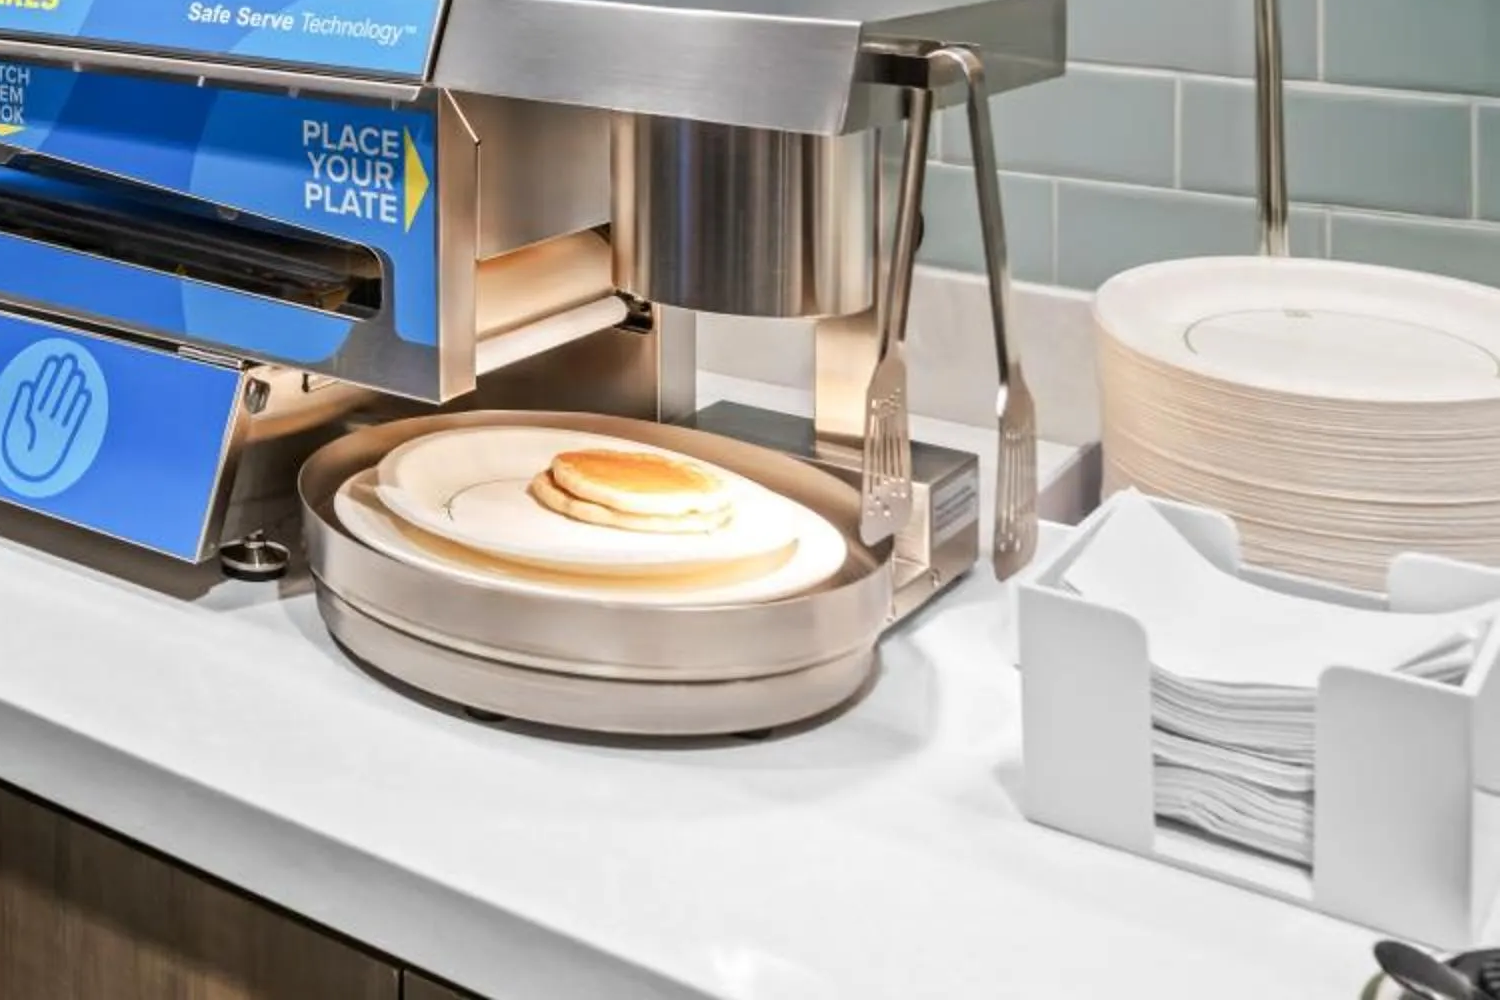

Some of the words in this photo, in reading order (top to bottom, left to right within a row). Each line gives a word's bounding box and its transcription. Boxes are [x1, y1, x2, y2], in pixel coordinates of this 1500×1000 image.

[188, 2, 230, 25] Safe
[236, 7, 294, 31] Serve
[303, 119, 399, 158] PLACE
[307, 151, 394, 190] YOUR
[305, 181, 398, 223] PLATE
